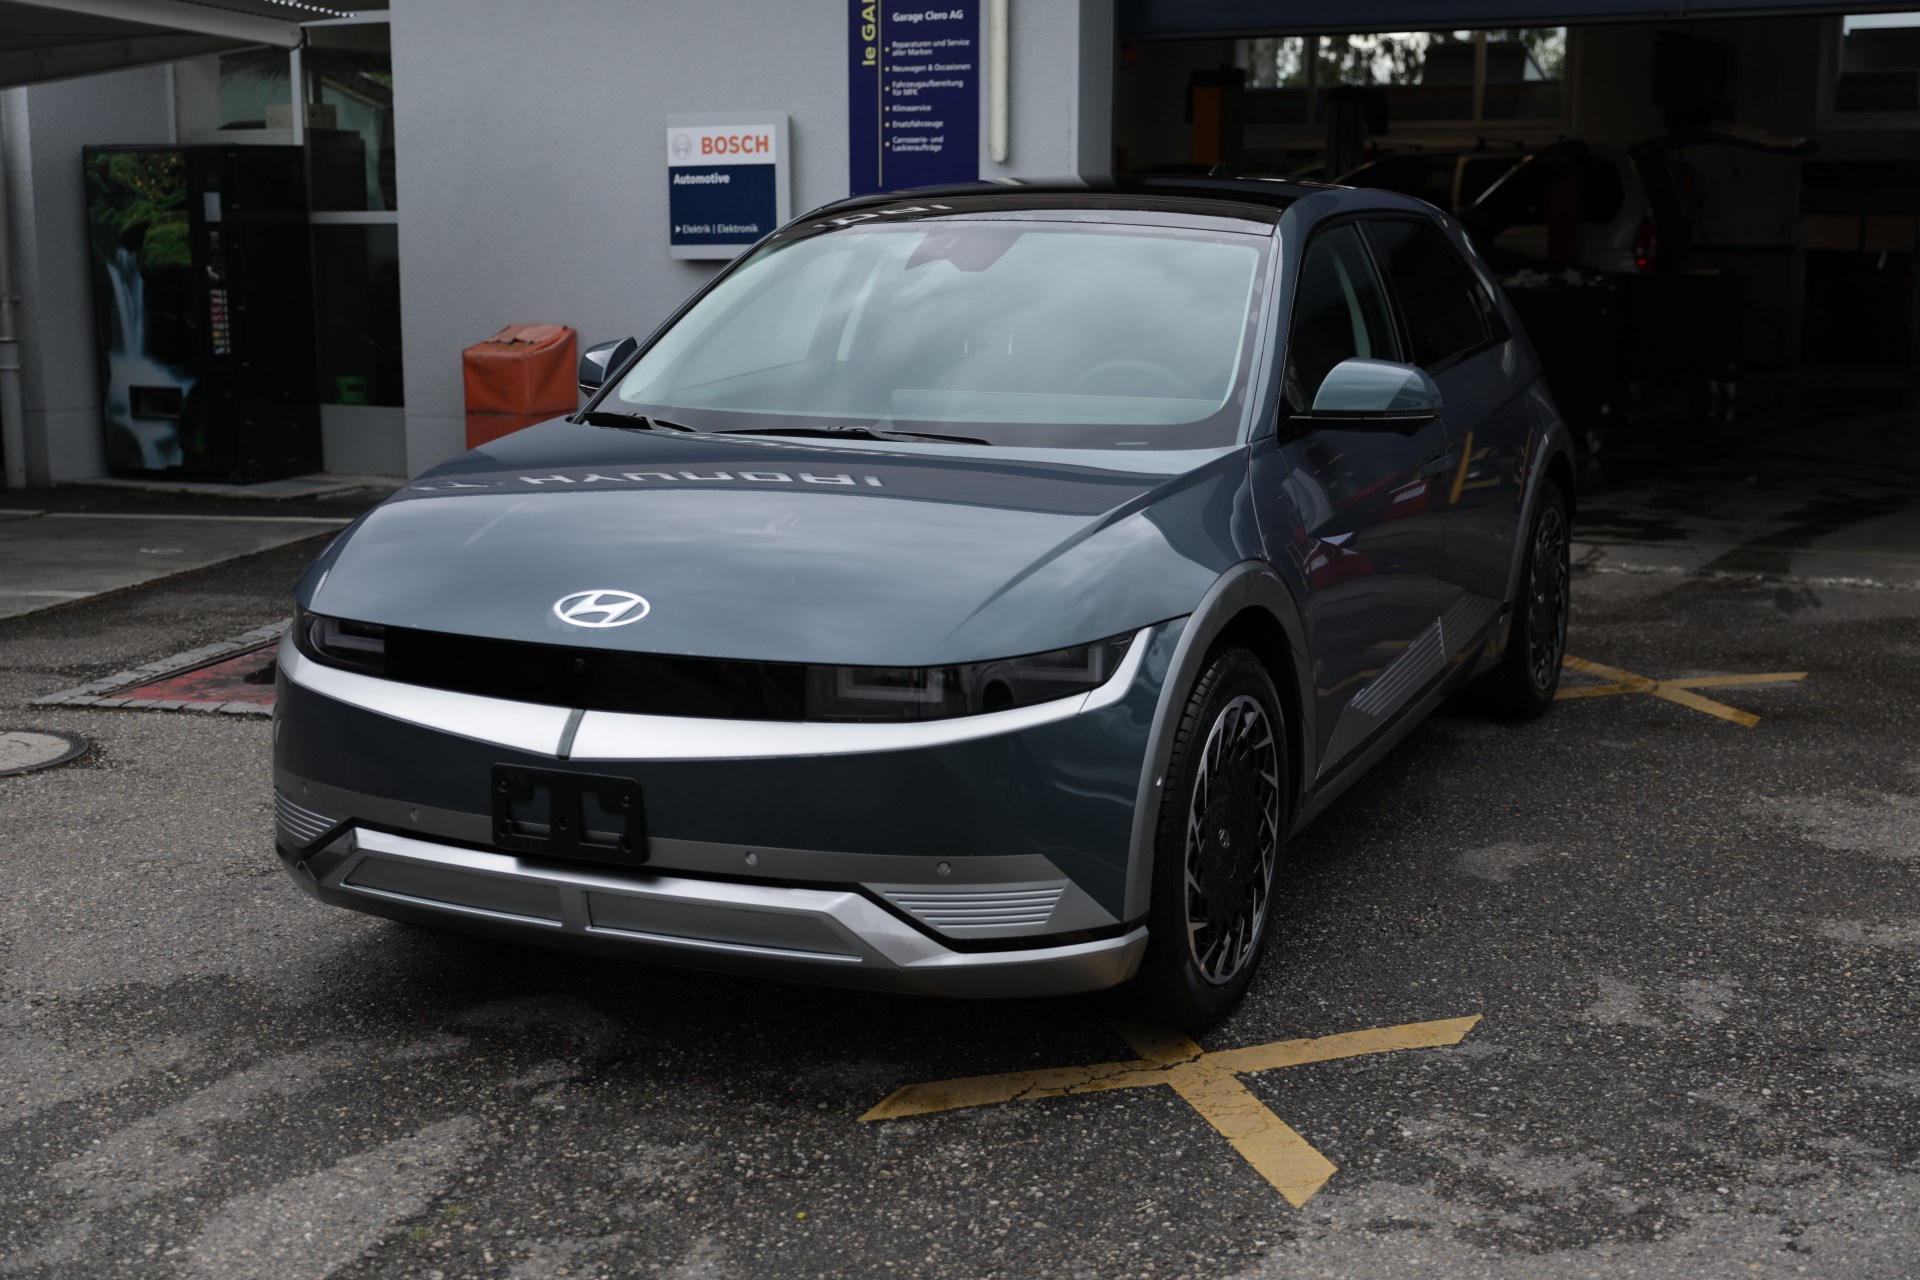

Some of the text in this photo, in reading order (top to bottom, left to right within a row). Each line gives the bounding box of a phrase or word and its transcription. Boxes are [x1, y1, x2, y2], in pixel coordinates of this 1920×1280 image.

[892, 9, 963, 23] Garage Clero AG
[892, 41, 931, 49] Reparaturen
[862, 46, 876, 66] le
[907, 48, 932, 56] Marken
[892, 65, 926, 73] Neuwagen
[934, 63, 971, 71] Occasionen
[892, 80, 963, 89] Fahrzeugaufbereitung
[892, 120, 943, 129] Ersatzfahrzeuge
[701, 135, 769, 155] BOSCH
[892, 144, 942, 153] Lackieraufträge
[673, 172, 730, 185] Automotive
[682, 224, 758, 234] Elektrik Elektronik
